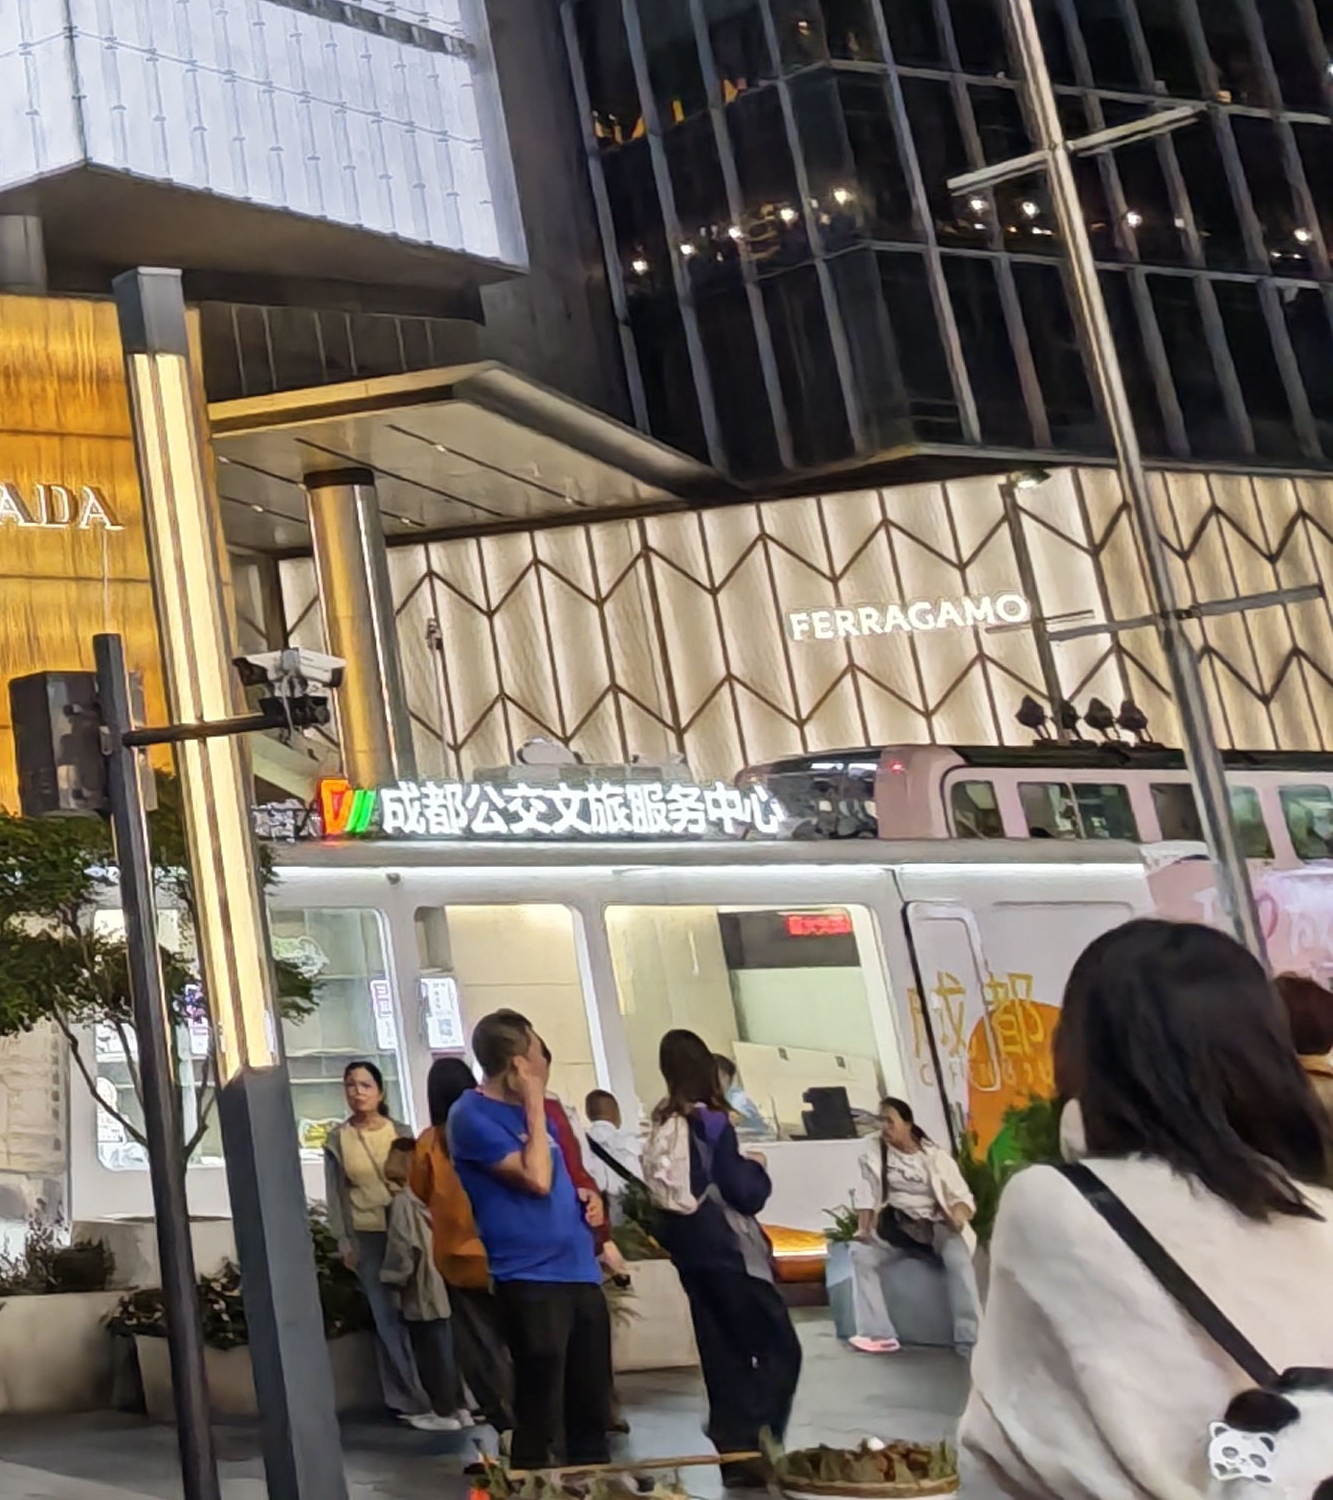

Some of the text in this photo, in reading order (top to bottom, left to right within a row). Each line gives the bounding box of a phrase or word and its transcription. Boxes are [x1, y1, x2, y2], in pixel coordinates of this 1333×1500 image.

[789, 594, 1028, 641] FERRAGAMO
[381, 781, 784, 835] 成都公交文旅服务中心
